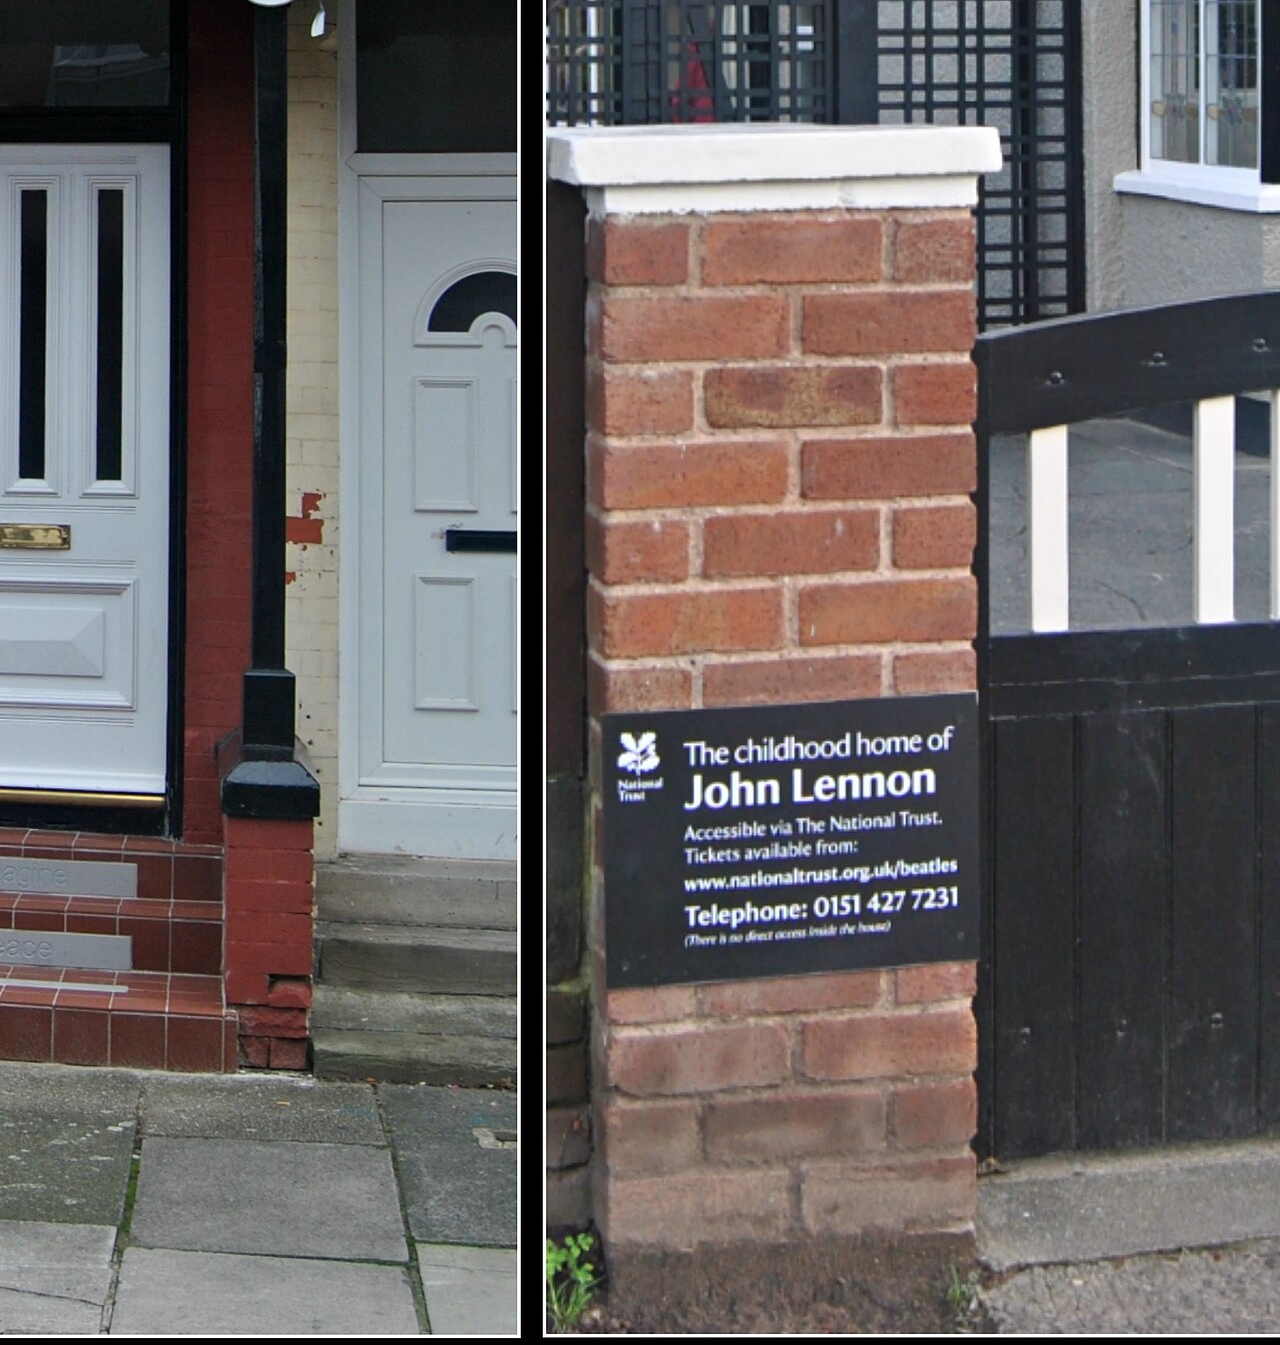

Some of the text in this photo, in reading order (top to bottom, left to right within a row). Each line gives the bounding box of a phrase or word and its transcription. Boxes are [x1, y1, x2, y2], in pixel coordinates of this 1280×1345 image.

[683, 725, 956, 767] The childhood home of
[617, 777, 664, 791] National
[619, 792, 646, 802] Trust
[683, 767, 937, 810] John Lennon
[684, 809, 943, 842] Accessible via The National Trust.
[684, 838, 859, 864] Tickets available from:
[684, 856, 959, 892] www.nationaltrust.org.uk/beatles
[684, 886, 959, 929] Telephone: 0151 427 7231
